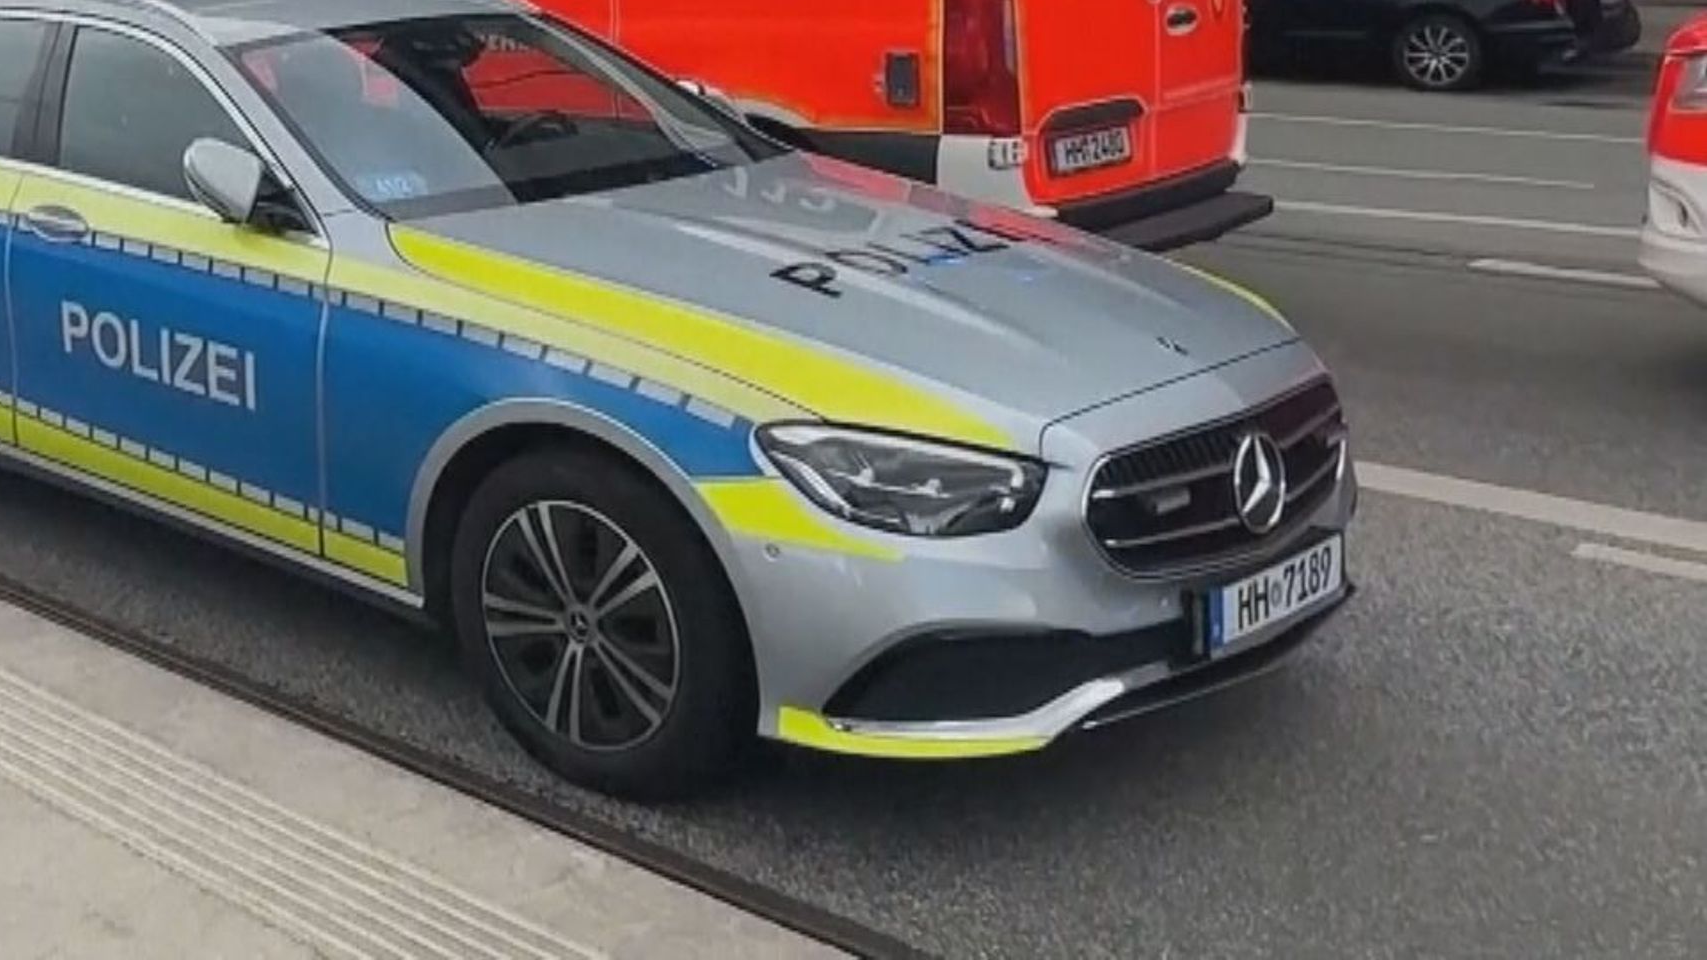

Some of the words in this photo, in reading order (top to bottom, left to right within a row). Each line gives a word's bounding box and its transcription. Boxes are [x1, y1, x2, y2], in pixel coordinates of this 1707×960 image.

[60, 300, 257, 412] POLIZEI
[1237, 574, 1270, 631] HH
[1282, 545, 1332, 608] 7189
